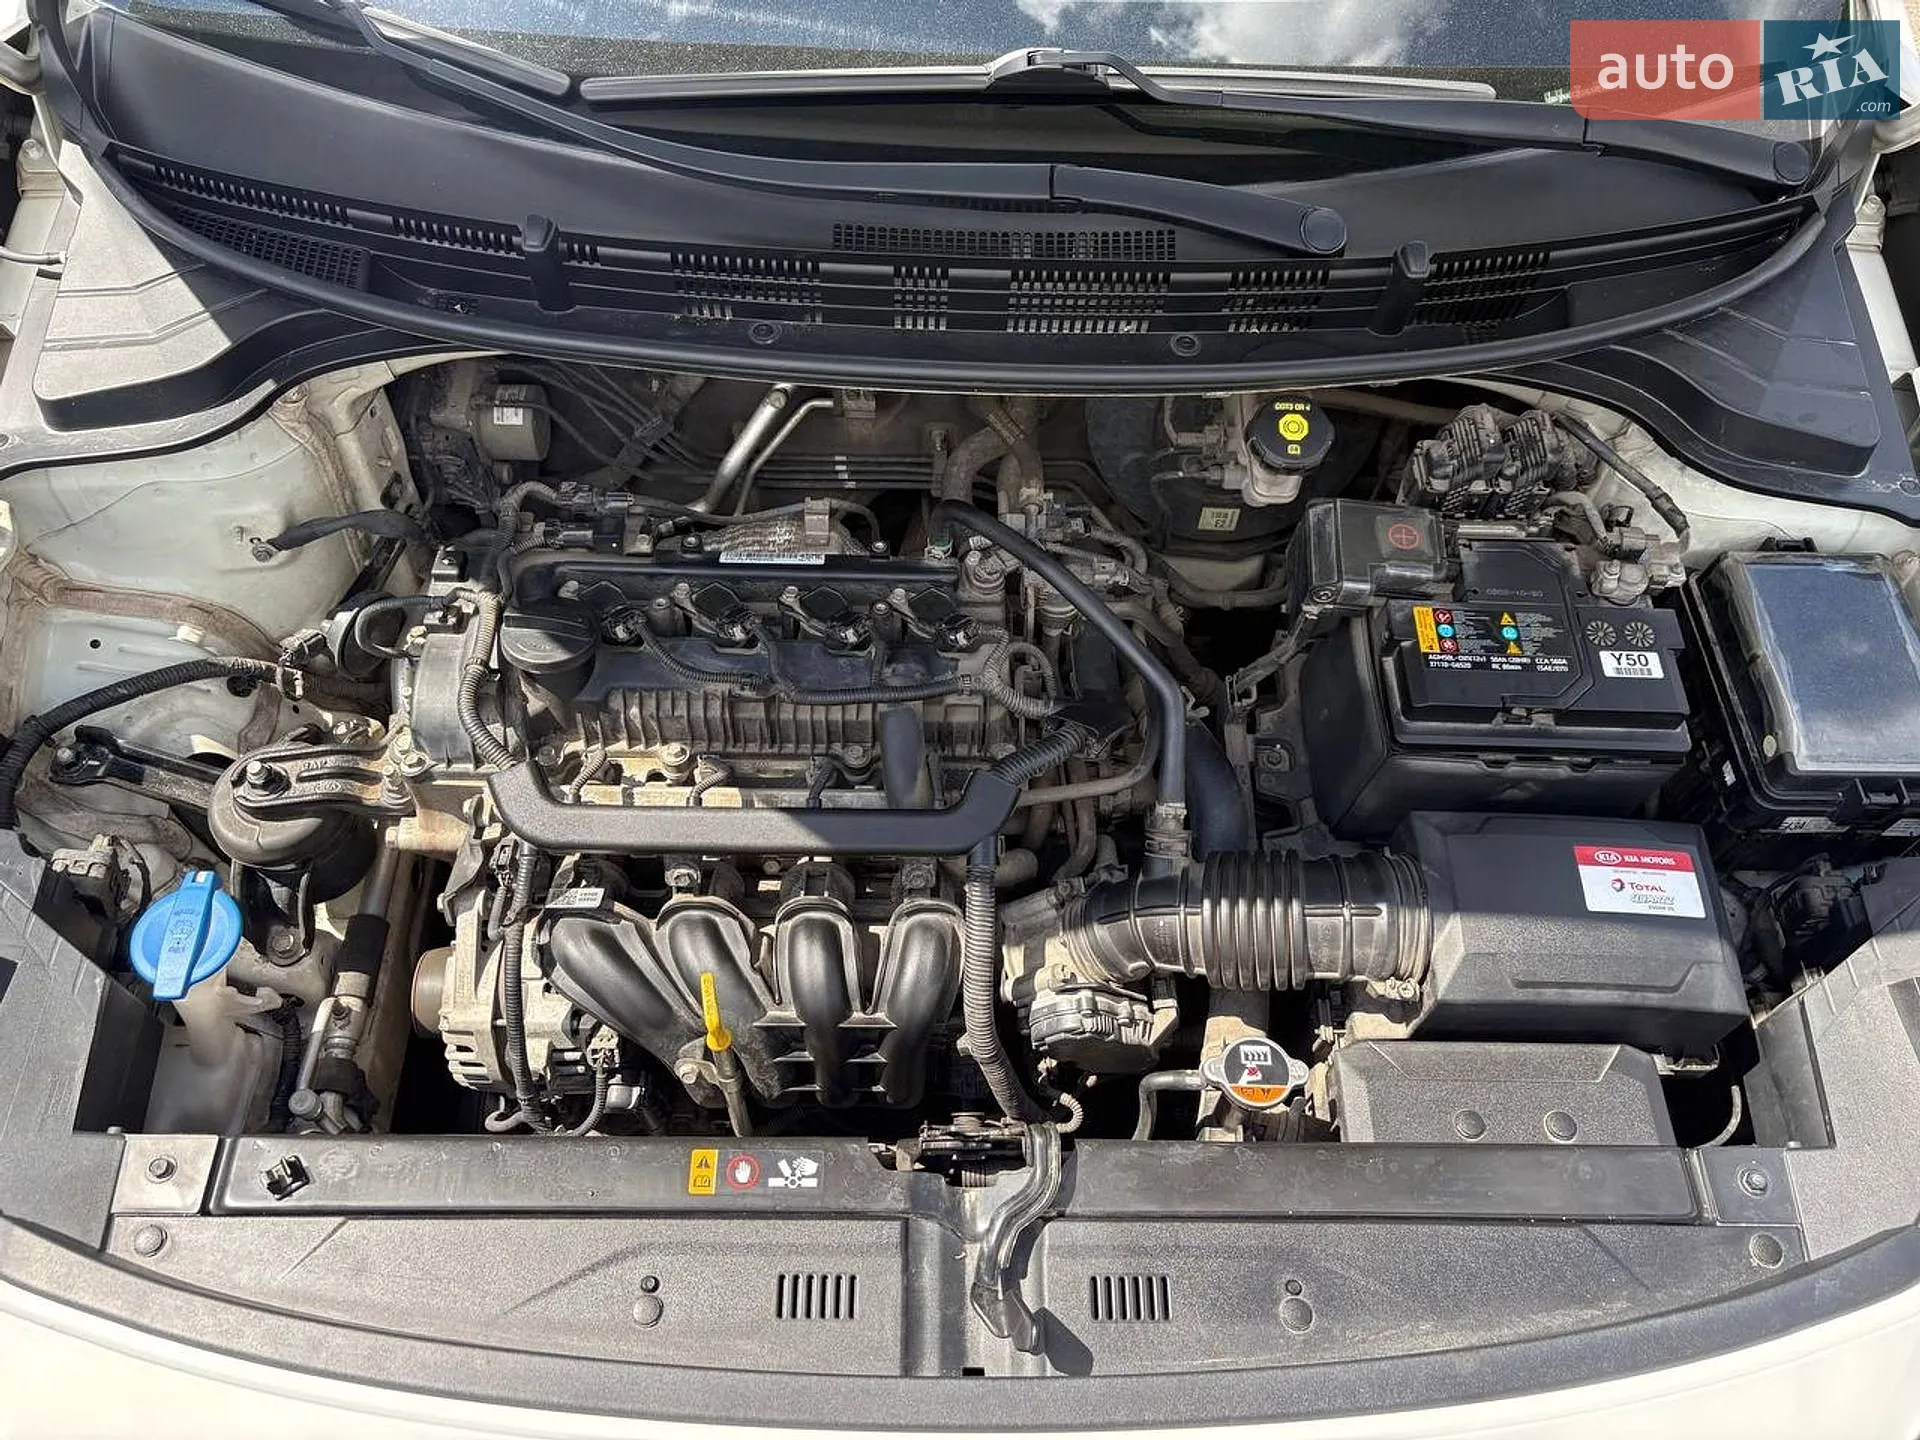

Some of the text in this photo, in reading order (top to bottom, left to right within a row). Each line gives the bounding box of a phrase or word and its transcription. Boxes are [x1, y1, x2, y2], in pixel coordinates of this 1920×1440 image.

[1609, 653, 1650, 668] Y50
[1597, 852, 1676, 866] KIA KIA MOTORS
[1628, 881, 1667, 893] TOTAL
